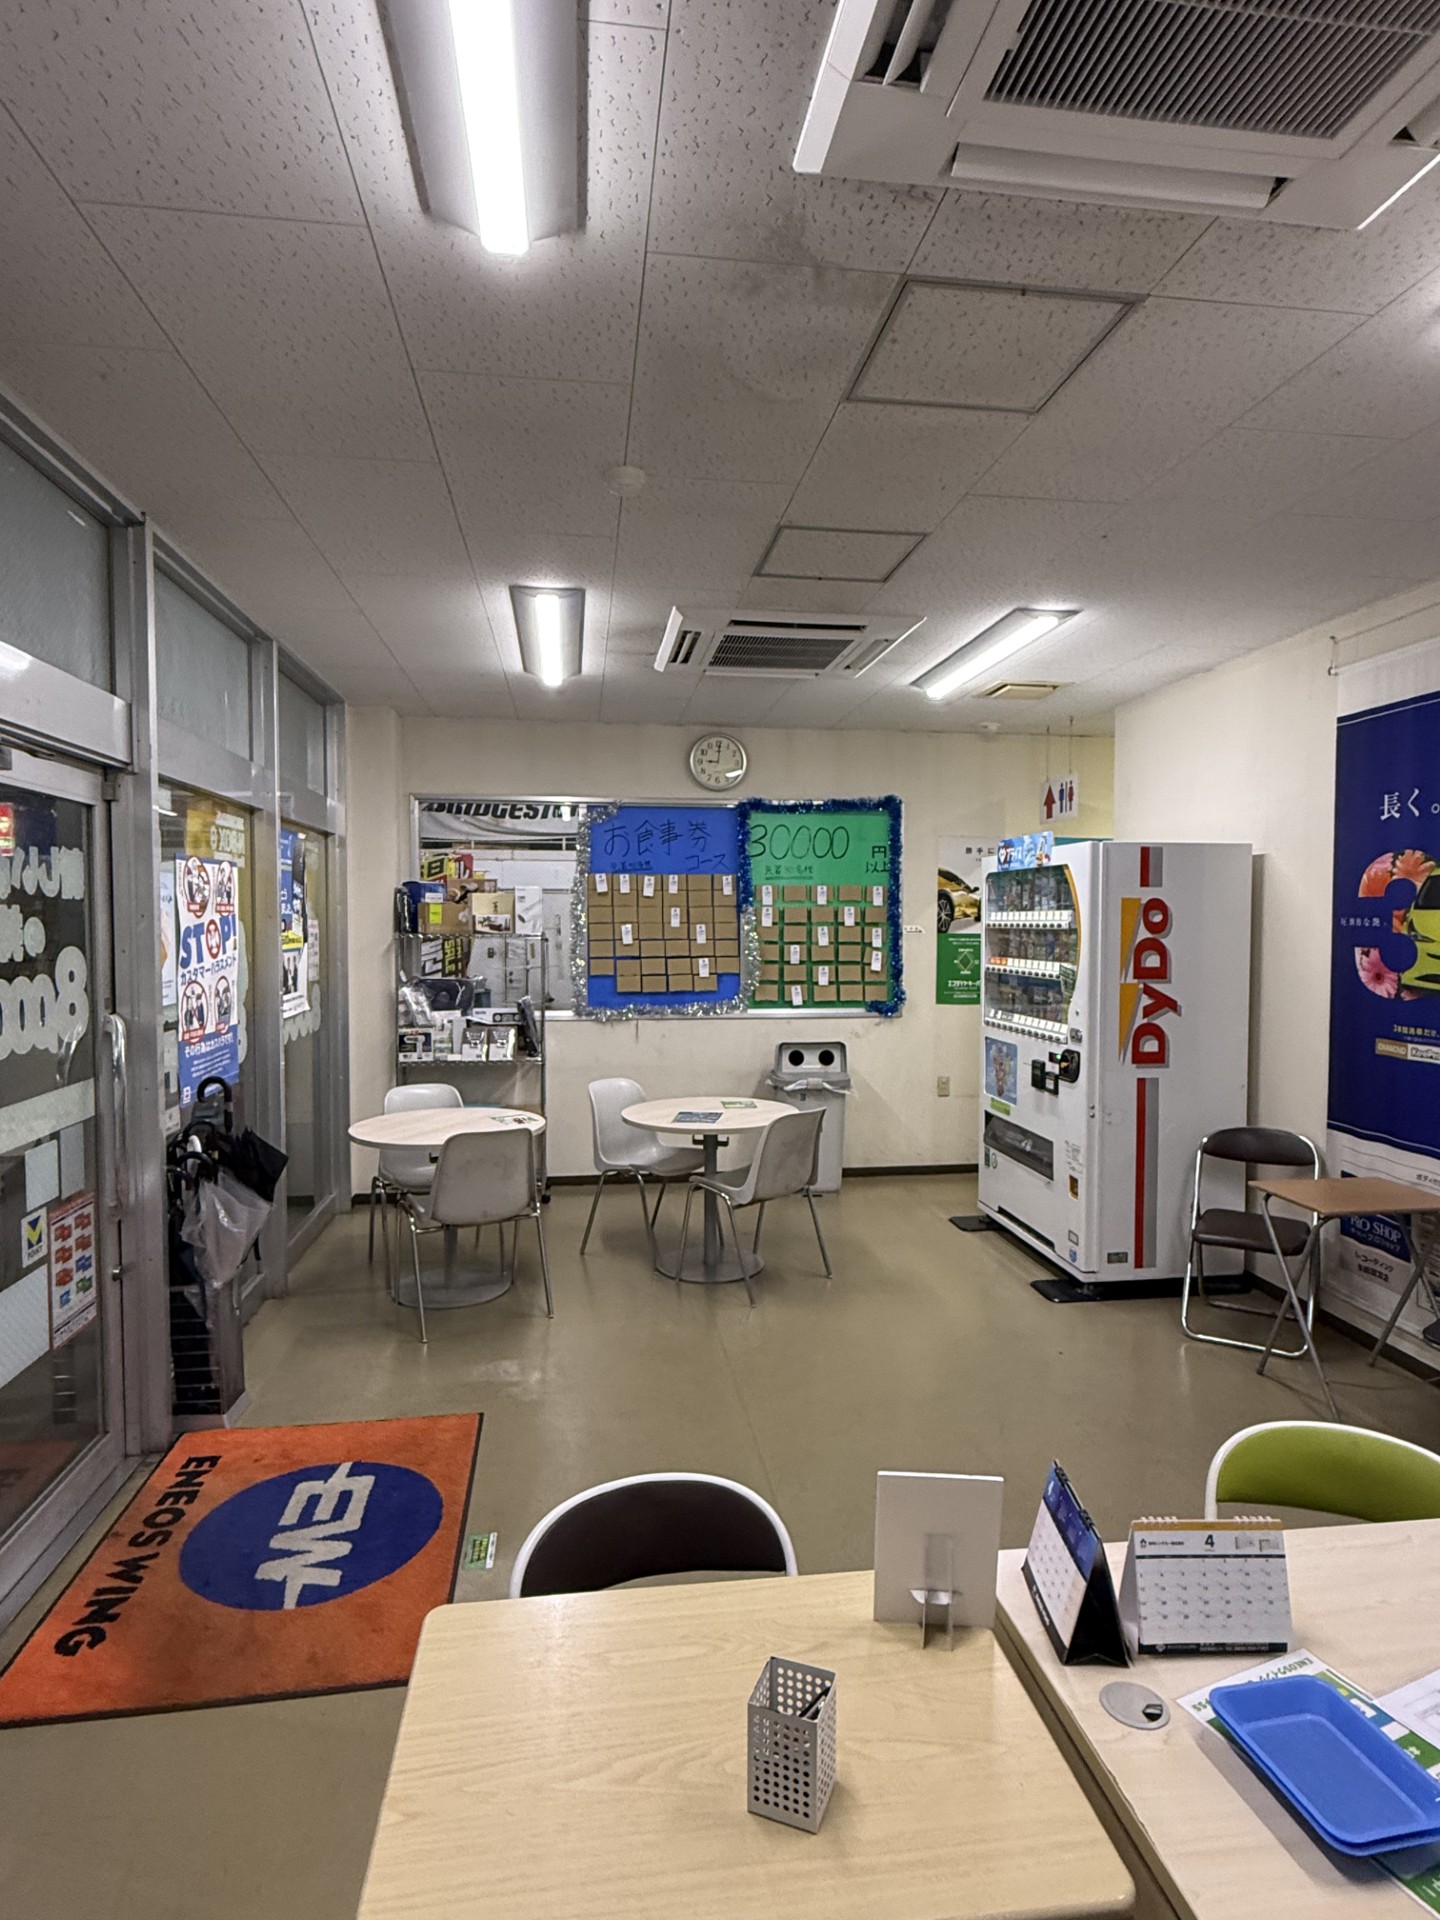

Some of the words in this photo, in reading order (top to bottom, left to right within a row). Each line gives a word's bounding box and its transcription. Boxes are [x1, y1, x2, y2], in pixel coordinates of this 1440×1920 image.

[422, 802, 579, 820] BRIDGEST
[1380, 788, 1440, 820] 長く。
[604, 819, 711, 857] お食事券
[751, 824, 849, 859] 30000
[872, 846, 887, 859] 円
[685, 854, 730, 871] コース
[866, 861, 889, 873] 以上
[1131, 898, 1179, 1066] DyDo
[129, 1455, 222, 1547] ENEOS
[1204, 1534, 1215, 1548] 4
[54, 1552, 160, 1657] WING
